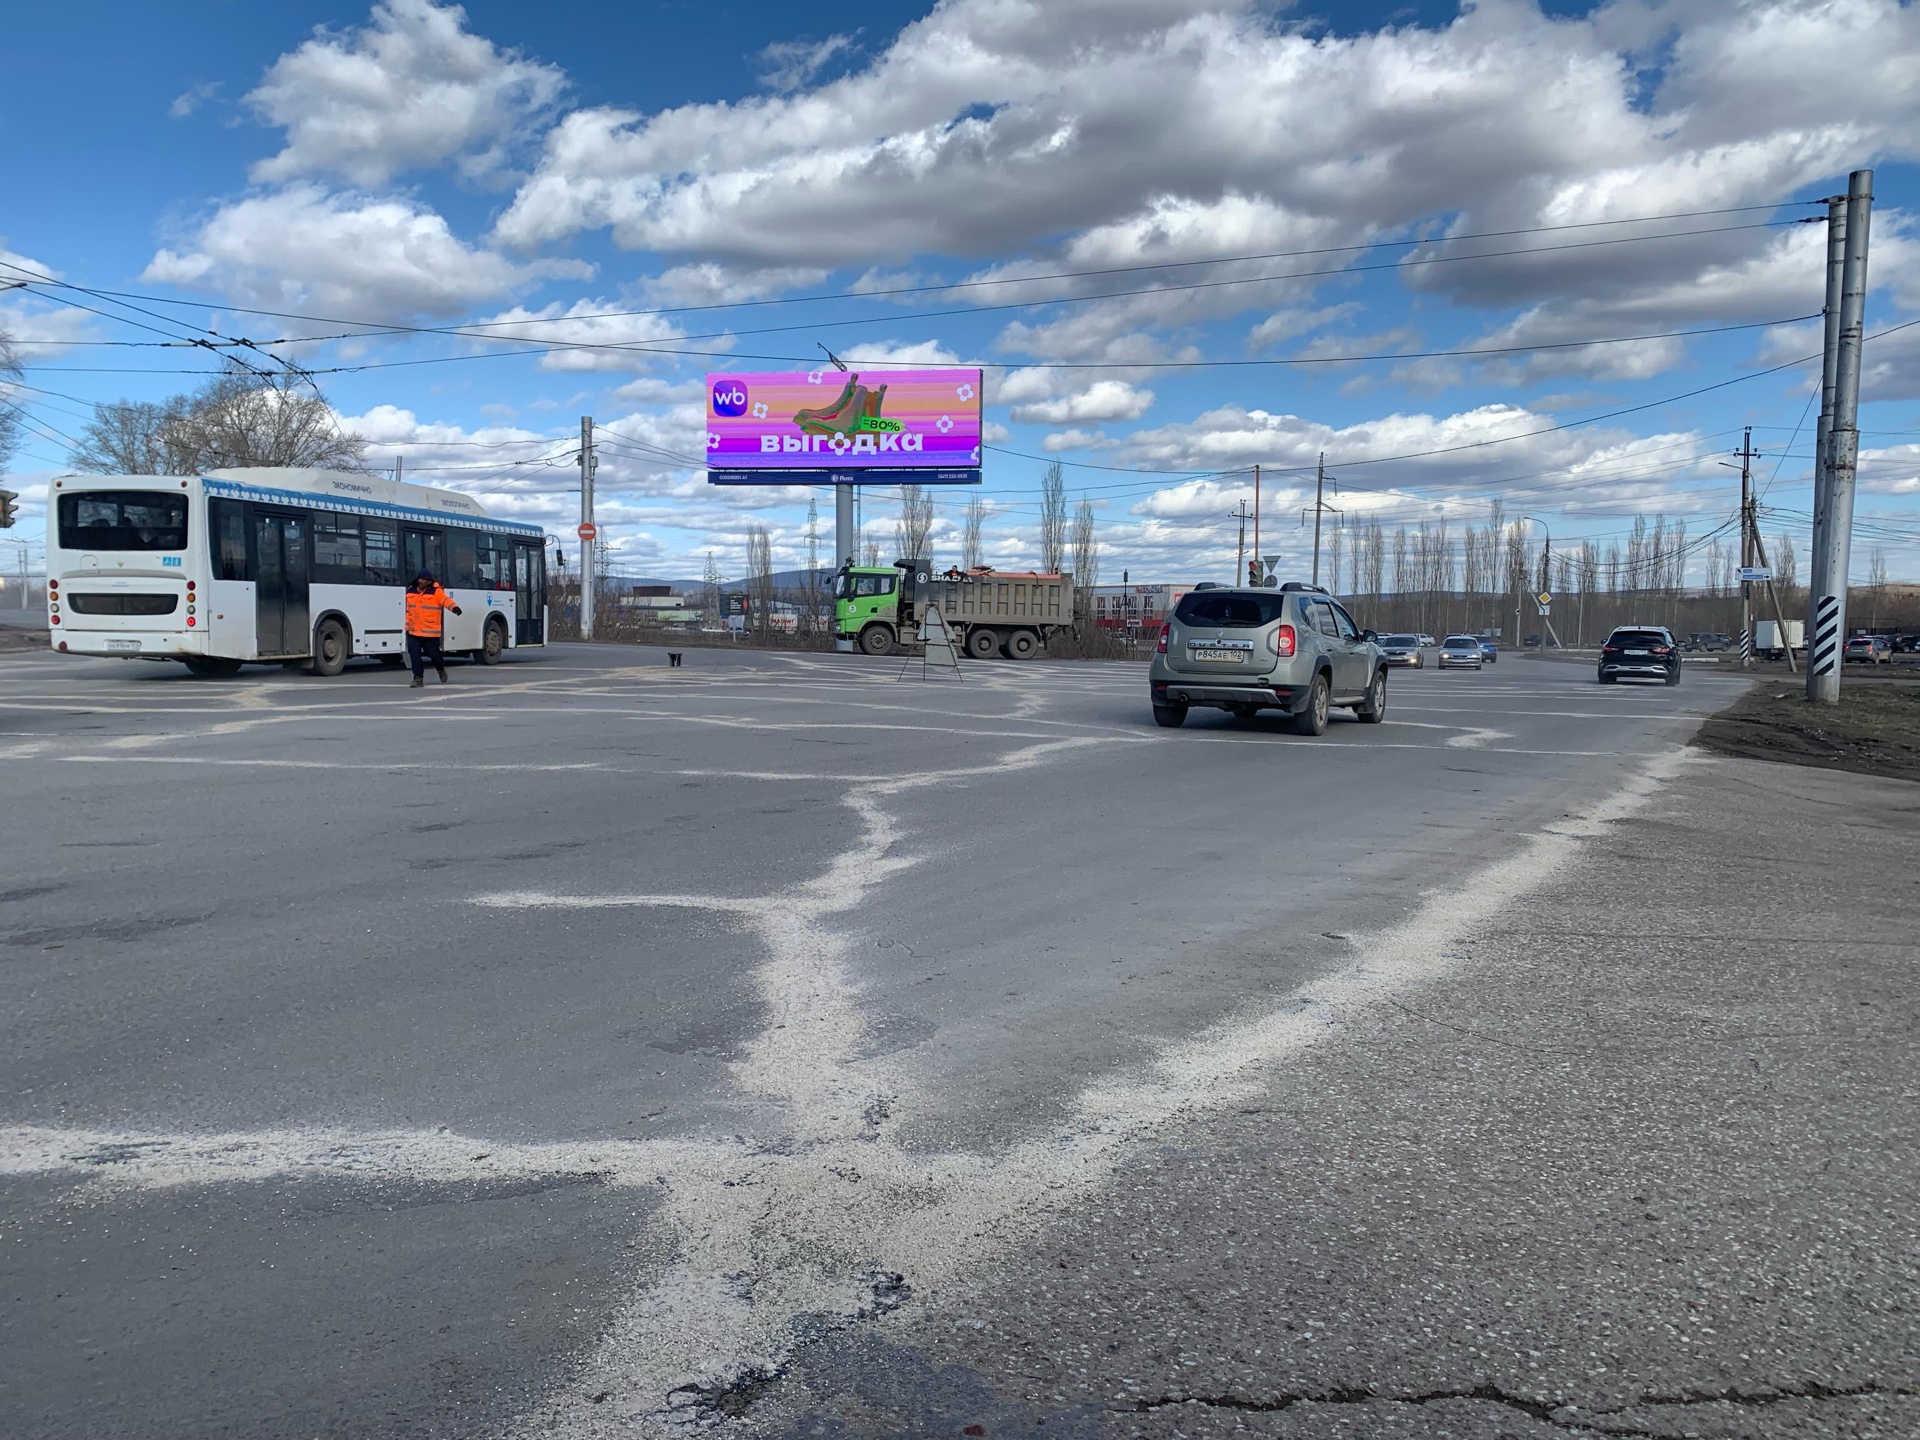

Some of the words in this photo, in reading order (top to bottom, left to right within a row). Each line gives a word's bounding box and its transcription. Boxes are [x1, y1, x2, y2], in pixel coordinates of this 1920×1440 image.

[715, 387, 745, 405] wb
[332, 481, 371, 494] ЭКОНОМИЧНО
[1230, 651, 1242, 659] 102
